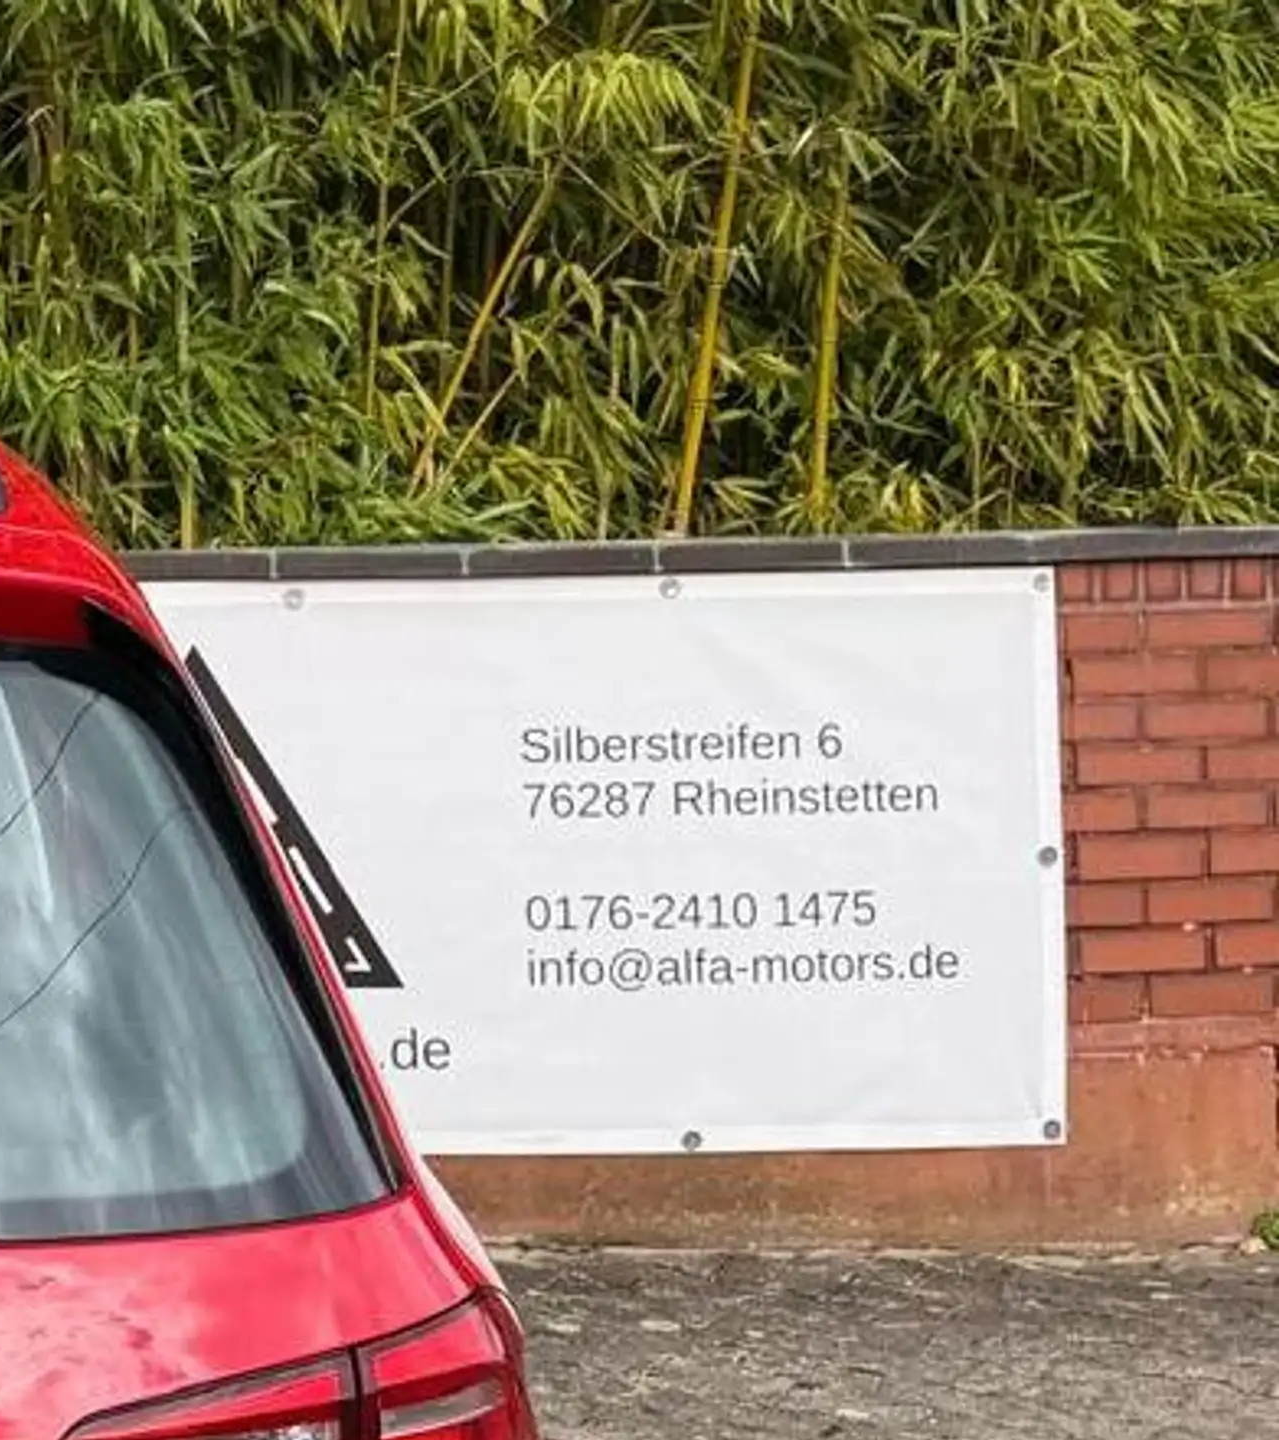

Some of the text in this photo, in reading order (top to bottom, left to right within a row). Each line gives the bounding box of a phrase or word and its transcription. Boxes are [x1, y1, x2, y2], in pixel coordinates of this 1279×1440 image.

[521, 723, 843, 764] Silberstreifen 6
[523, 777, 939, 819] 76287 Rheinstetten
[525, 889, 877, 932] 0176-2410 1475
[527, 943, 960, 993] info@alfa-motors.de
